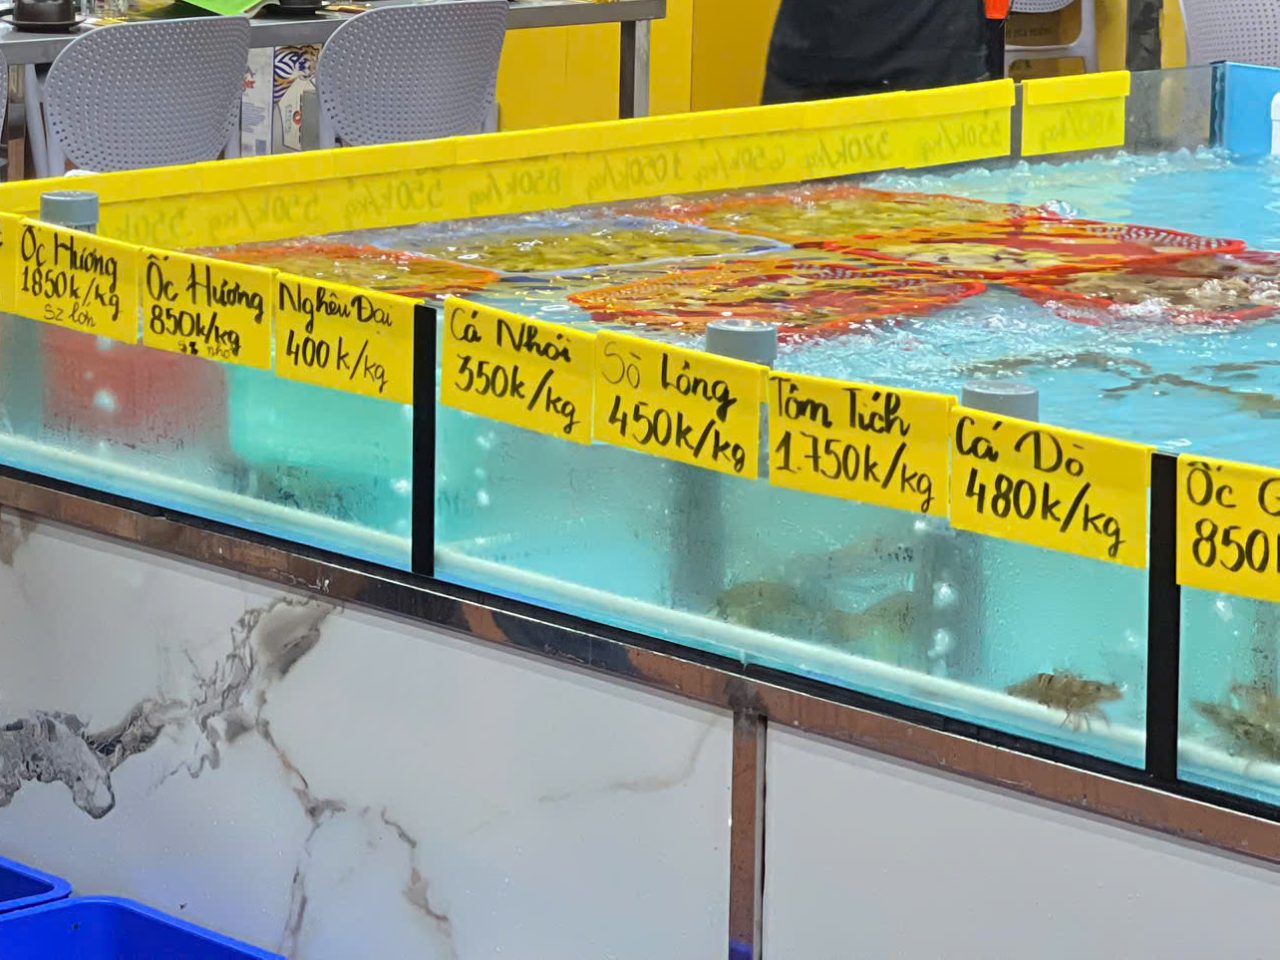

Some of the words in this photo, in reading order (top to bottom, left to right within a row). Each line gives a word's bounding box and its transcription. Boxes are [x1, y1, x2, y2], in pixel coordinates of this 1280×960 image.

[21, 265, 122, 322] 1850k/kg
[149, 304, 241, 357] 850k/kg
[450, 307, 482, 342] Cá
[601, 341, 641, 389] Sò
[454, 353, 581, 434] 350k/kg
[845, 387, 910, 438] Tích
[608, 394, 747, 473] 450k/kg
[955, 415, 1003, 462] Cá
[775, 430, 935, 513] 1.750k/kg
[1186, 461, 1238, 509] Ốc
[965, 467, 1126, 558] 480k/kg
[1192, 518, 1280, 574] 850
